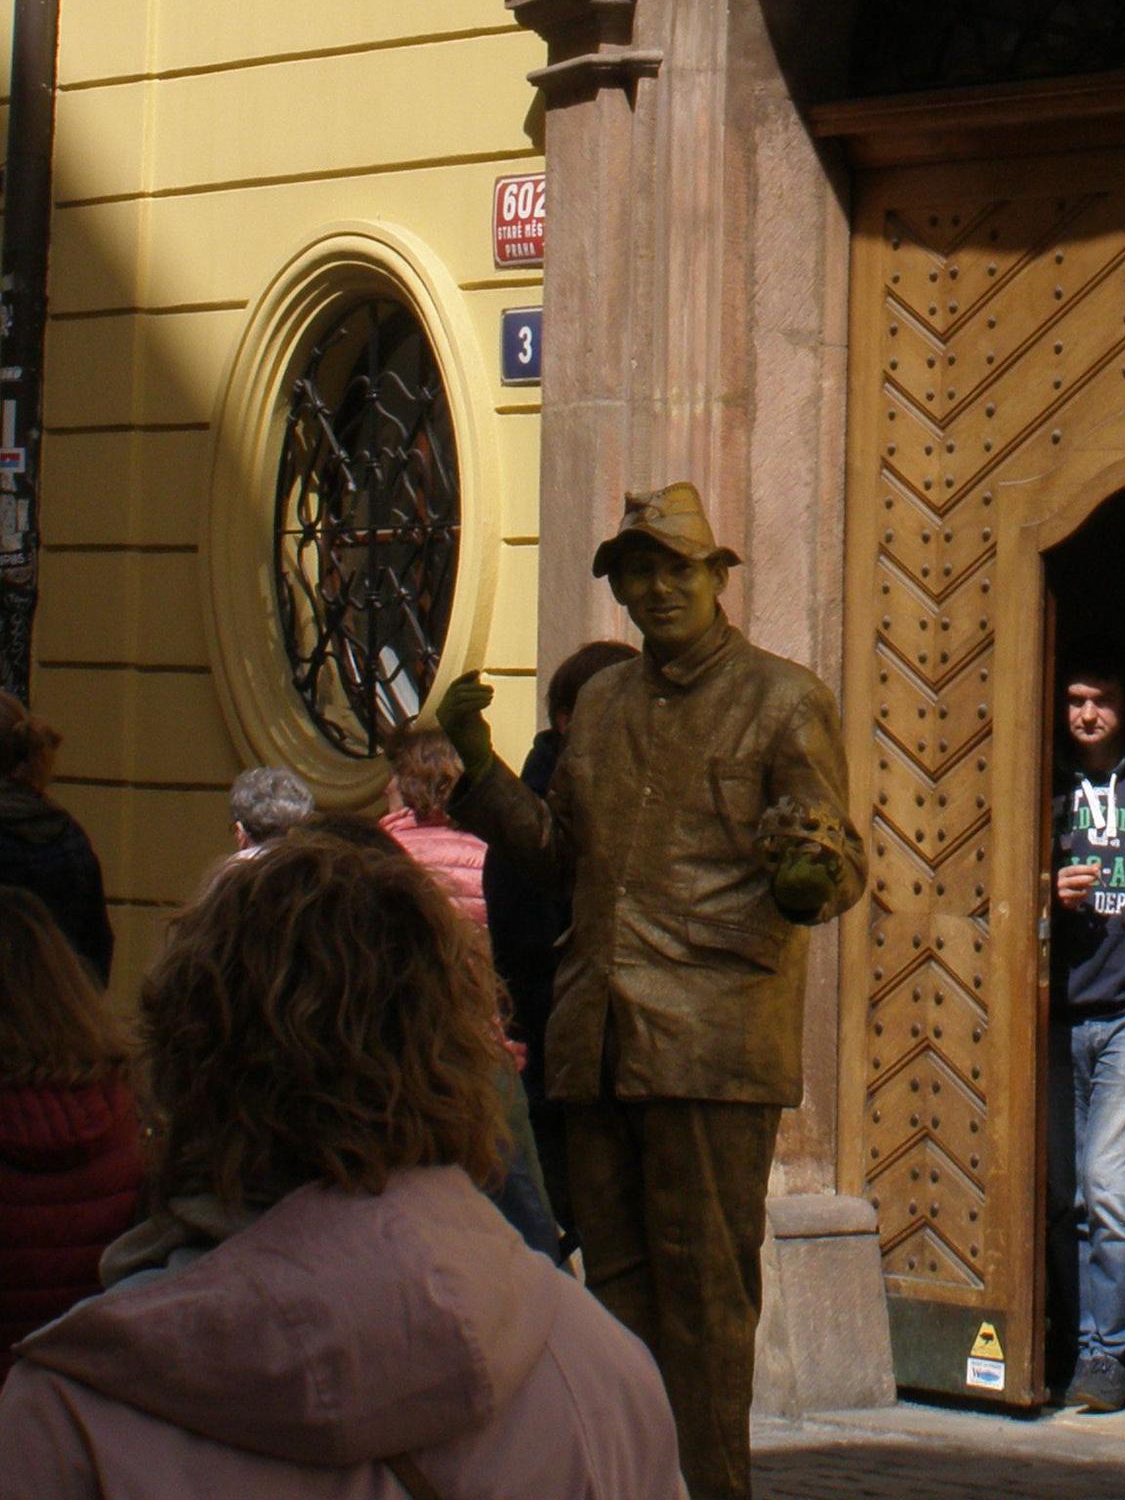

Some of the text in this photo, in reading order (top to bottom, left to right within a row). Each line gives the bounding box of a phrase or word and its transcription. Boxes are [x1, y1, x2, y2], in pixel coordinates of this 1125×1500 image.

[498, 221, 523, 240] STARÉ
[505, 242, 536, 258] PRAHA
[518, 326, 532, 364] 3
